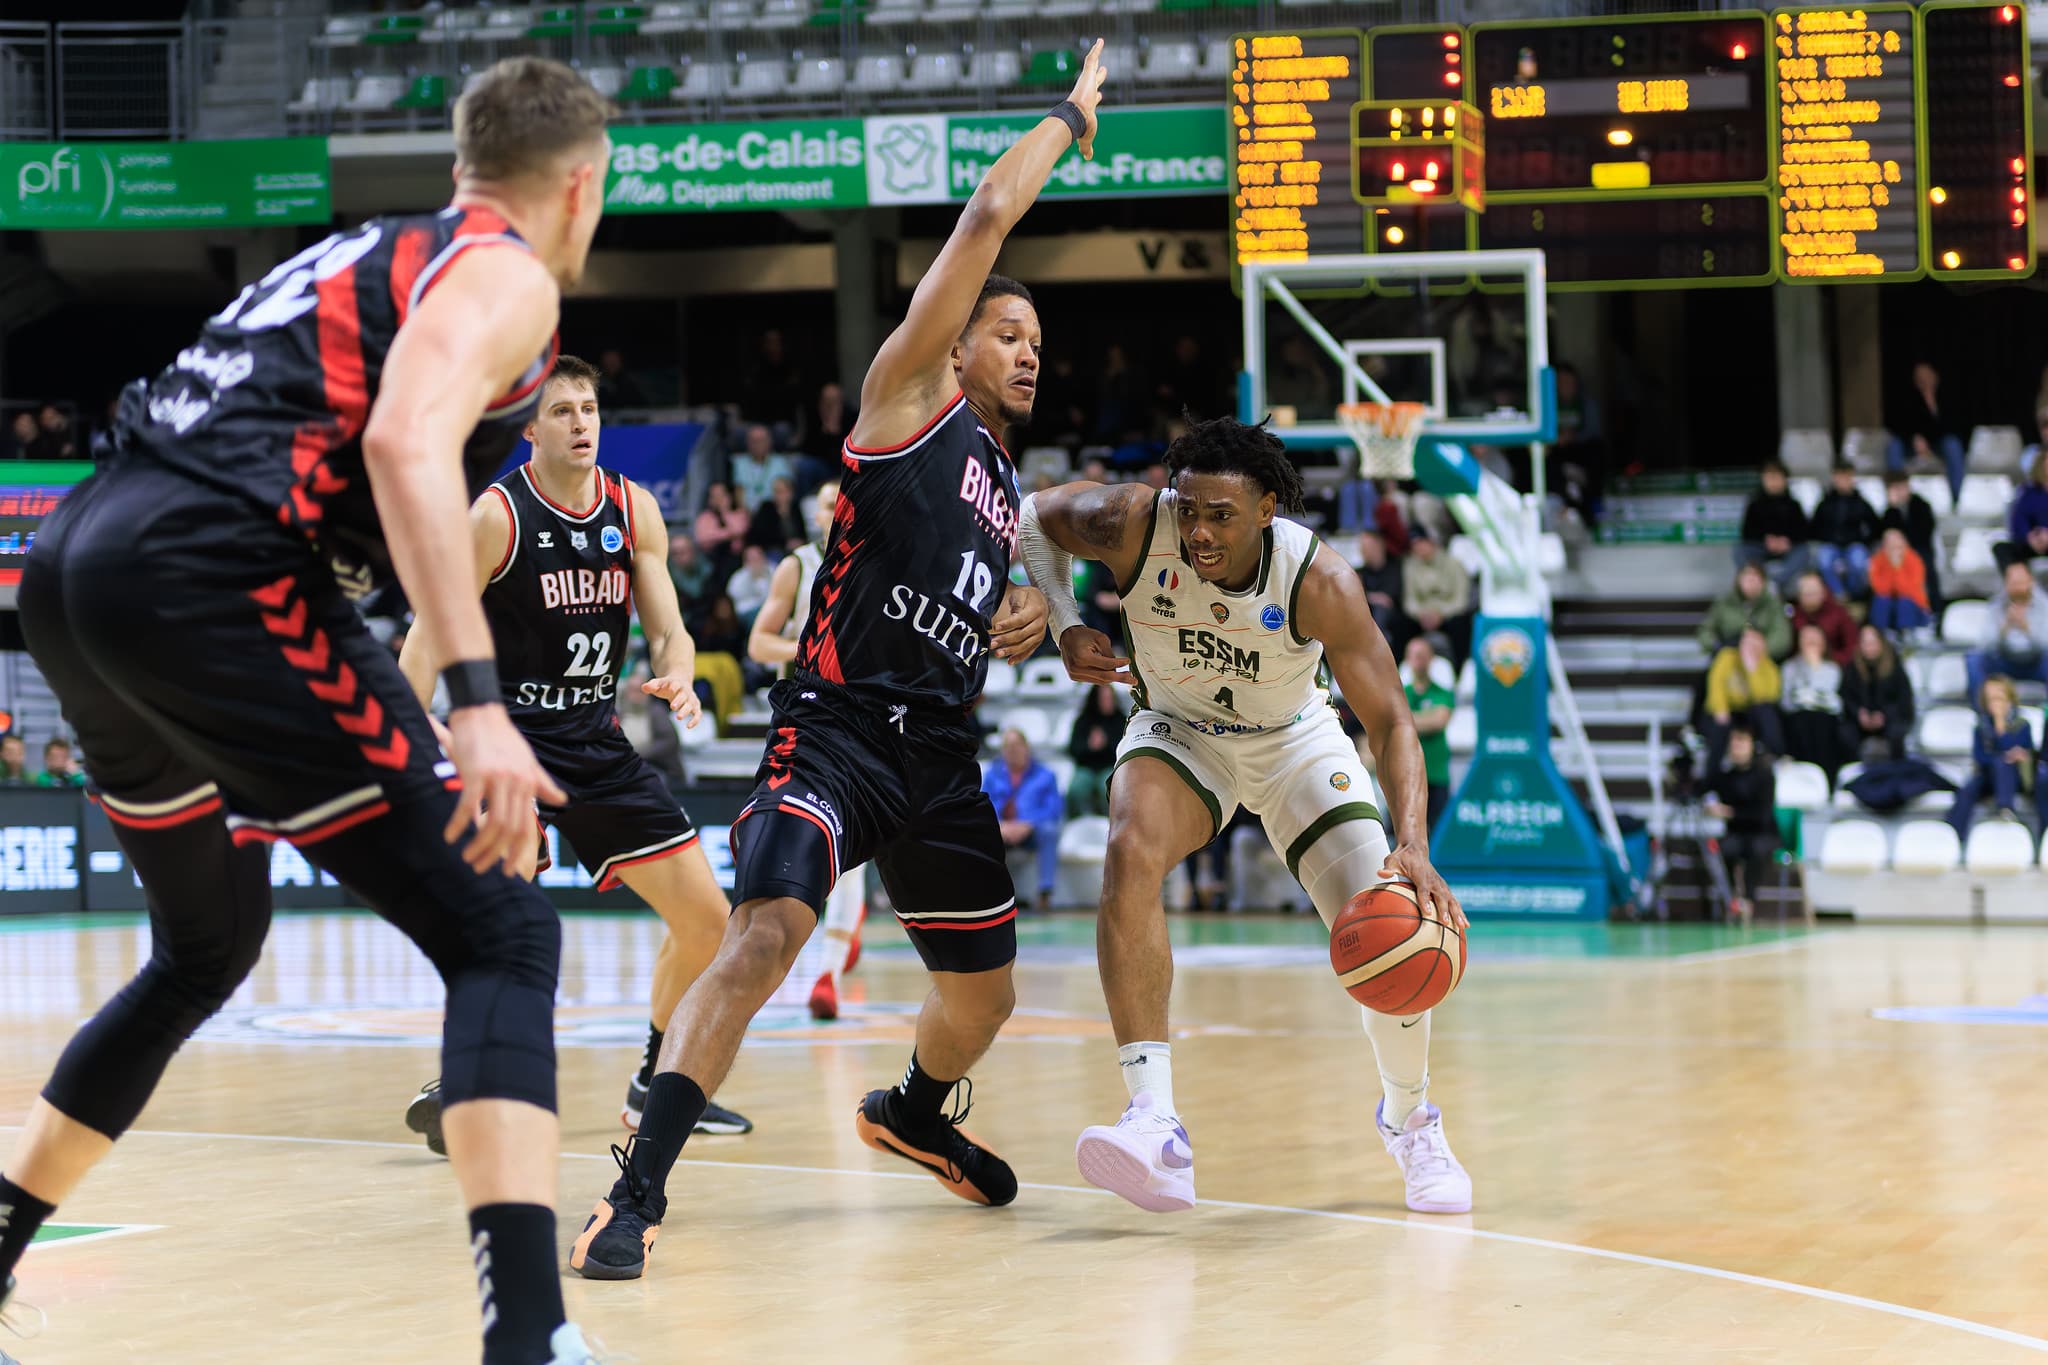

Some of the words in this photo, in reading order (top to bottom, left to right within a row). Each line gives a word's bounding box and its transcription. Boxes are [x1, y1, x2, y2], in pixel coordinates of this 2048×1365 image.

[18, 146, 80, 201] pfi
[672, 177, 834, 208] Département
[540, 568, 627, 609] BILBAO
[953, 550, 992, 614] 19
[882, 584, 988, 668] surn
[1178, 628, 1260, 673] ESSM
[563, 631, 611, 677] 22
[0, 825, 79, 891] ERIE
